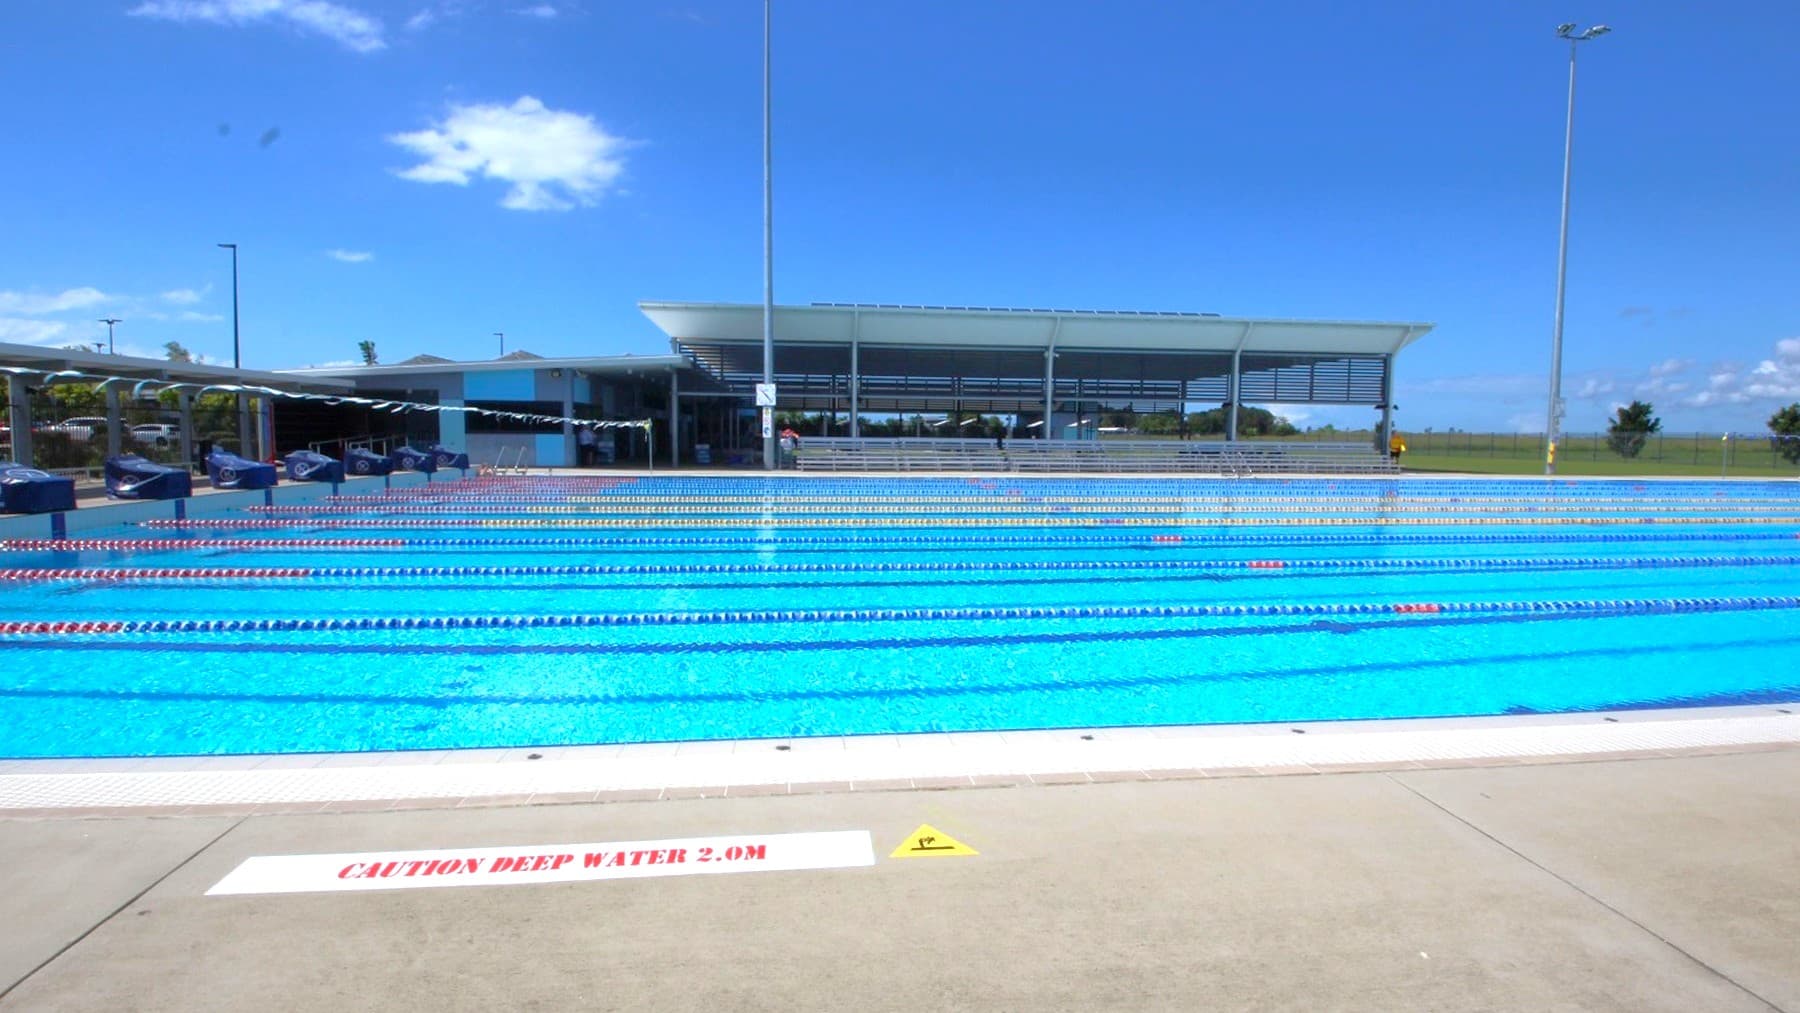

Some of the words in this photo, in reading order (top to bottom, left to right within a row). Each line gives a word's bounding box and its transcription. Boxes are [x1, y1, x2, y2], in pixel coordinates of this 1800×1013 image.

[338, 857, 485, 878] CAUTION
[488, 853, 573, 872] DEEP
[584, 848, 687, 868] WATER
[698, 844, 766, 862] 2.0M
